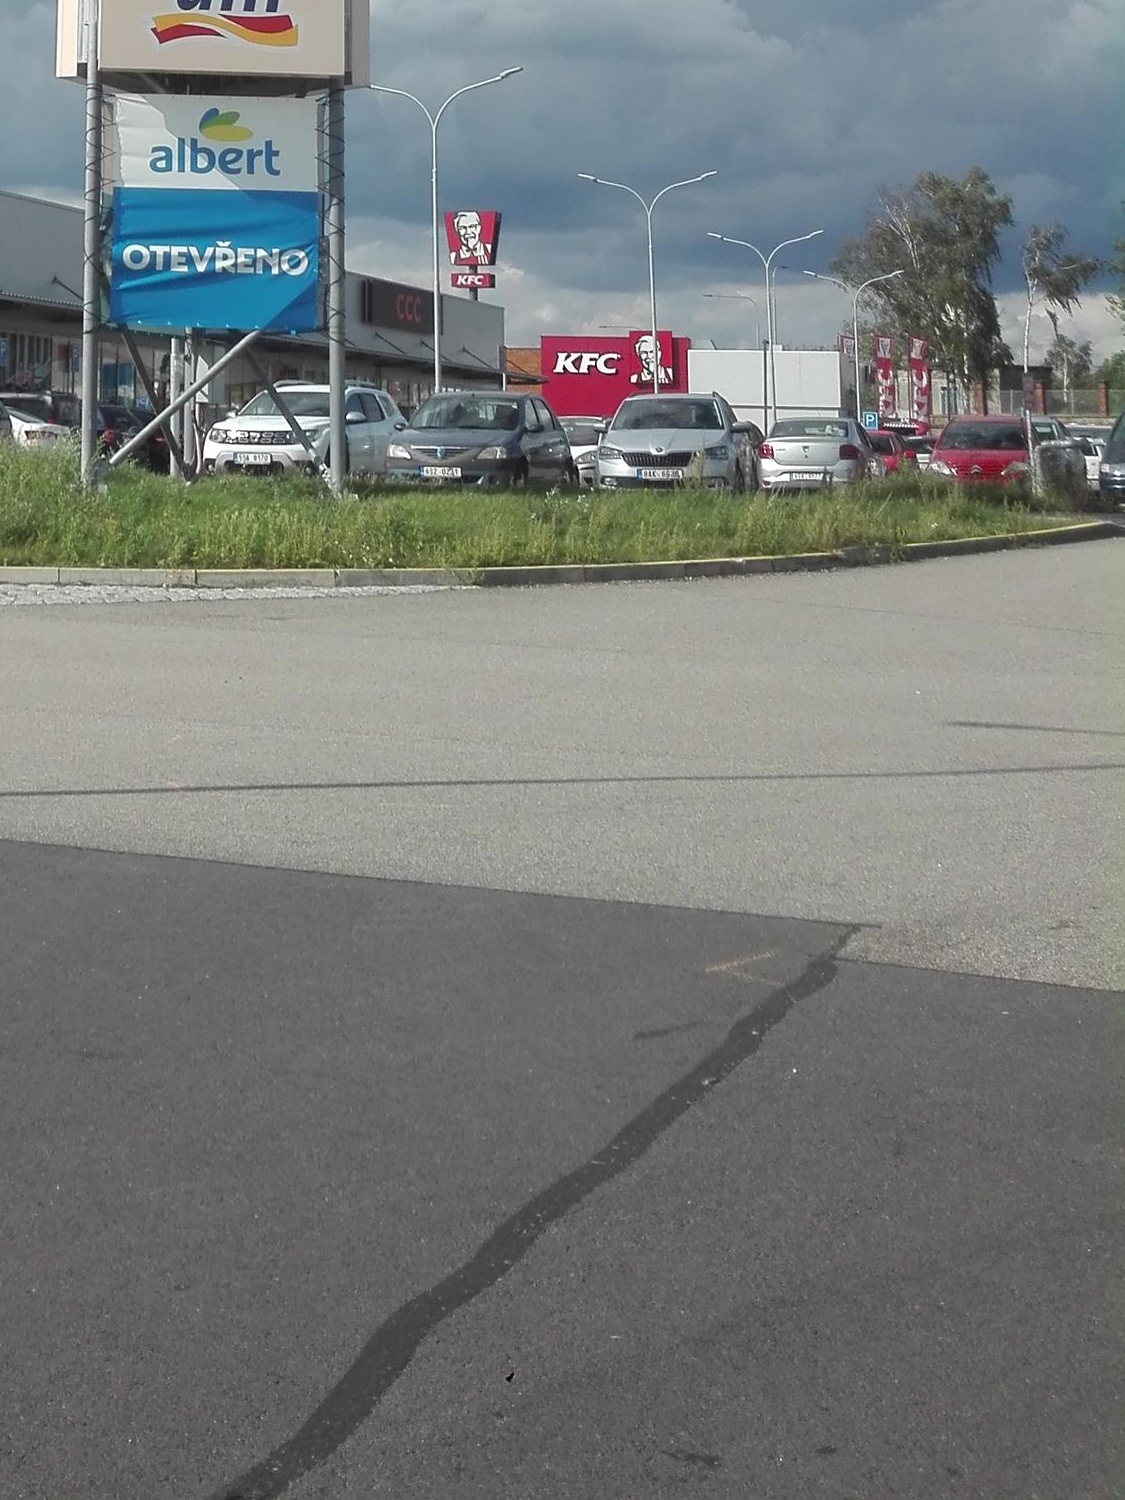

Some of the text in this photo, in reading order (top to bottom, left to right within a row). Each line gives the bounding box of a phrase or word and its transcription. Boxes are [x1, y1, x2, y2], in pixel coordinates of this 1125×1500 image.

[149, 137, 281, 176] albert
[122, 241, 309, 276] OTEVŘENO
[456, 274, 484, 286] KFC
[396, 294, 422, 323] CCC
[553, 352, 618, 374] KFC
[877, 367, 896, 419] KFC
[912, 366, 928, 422] KFC
[866, 414, 875, 426] P
